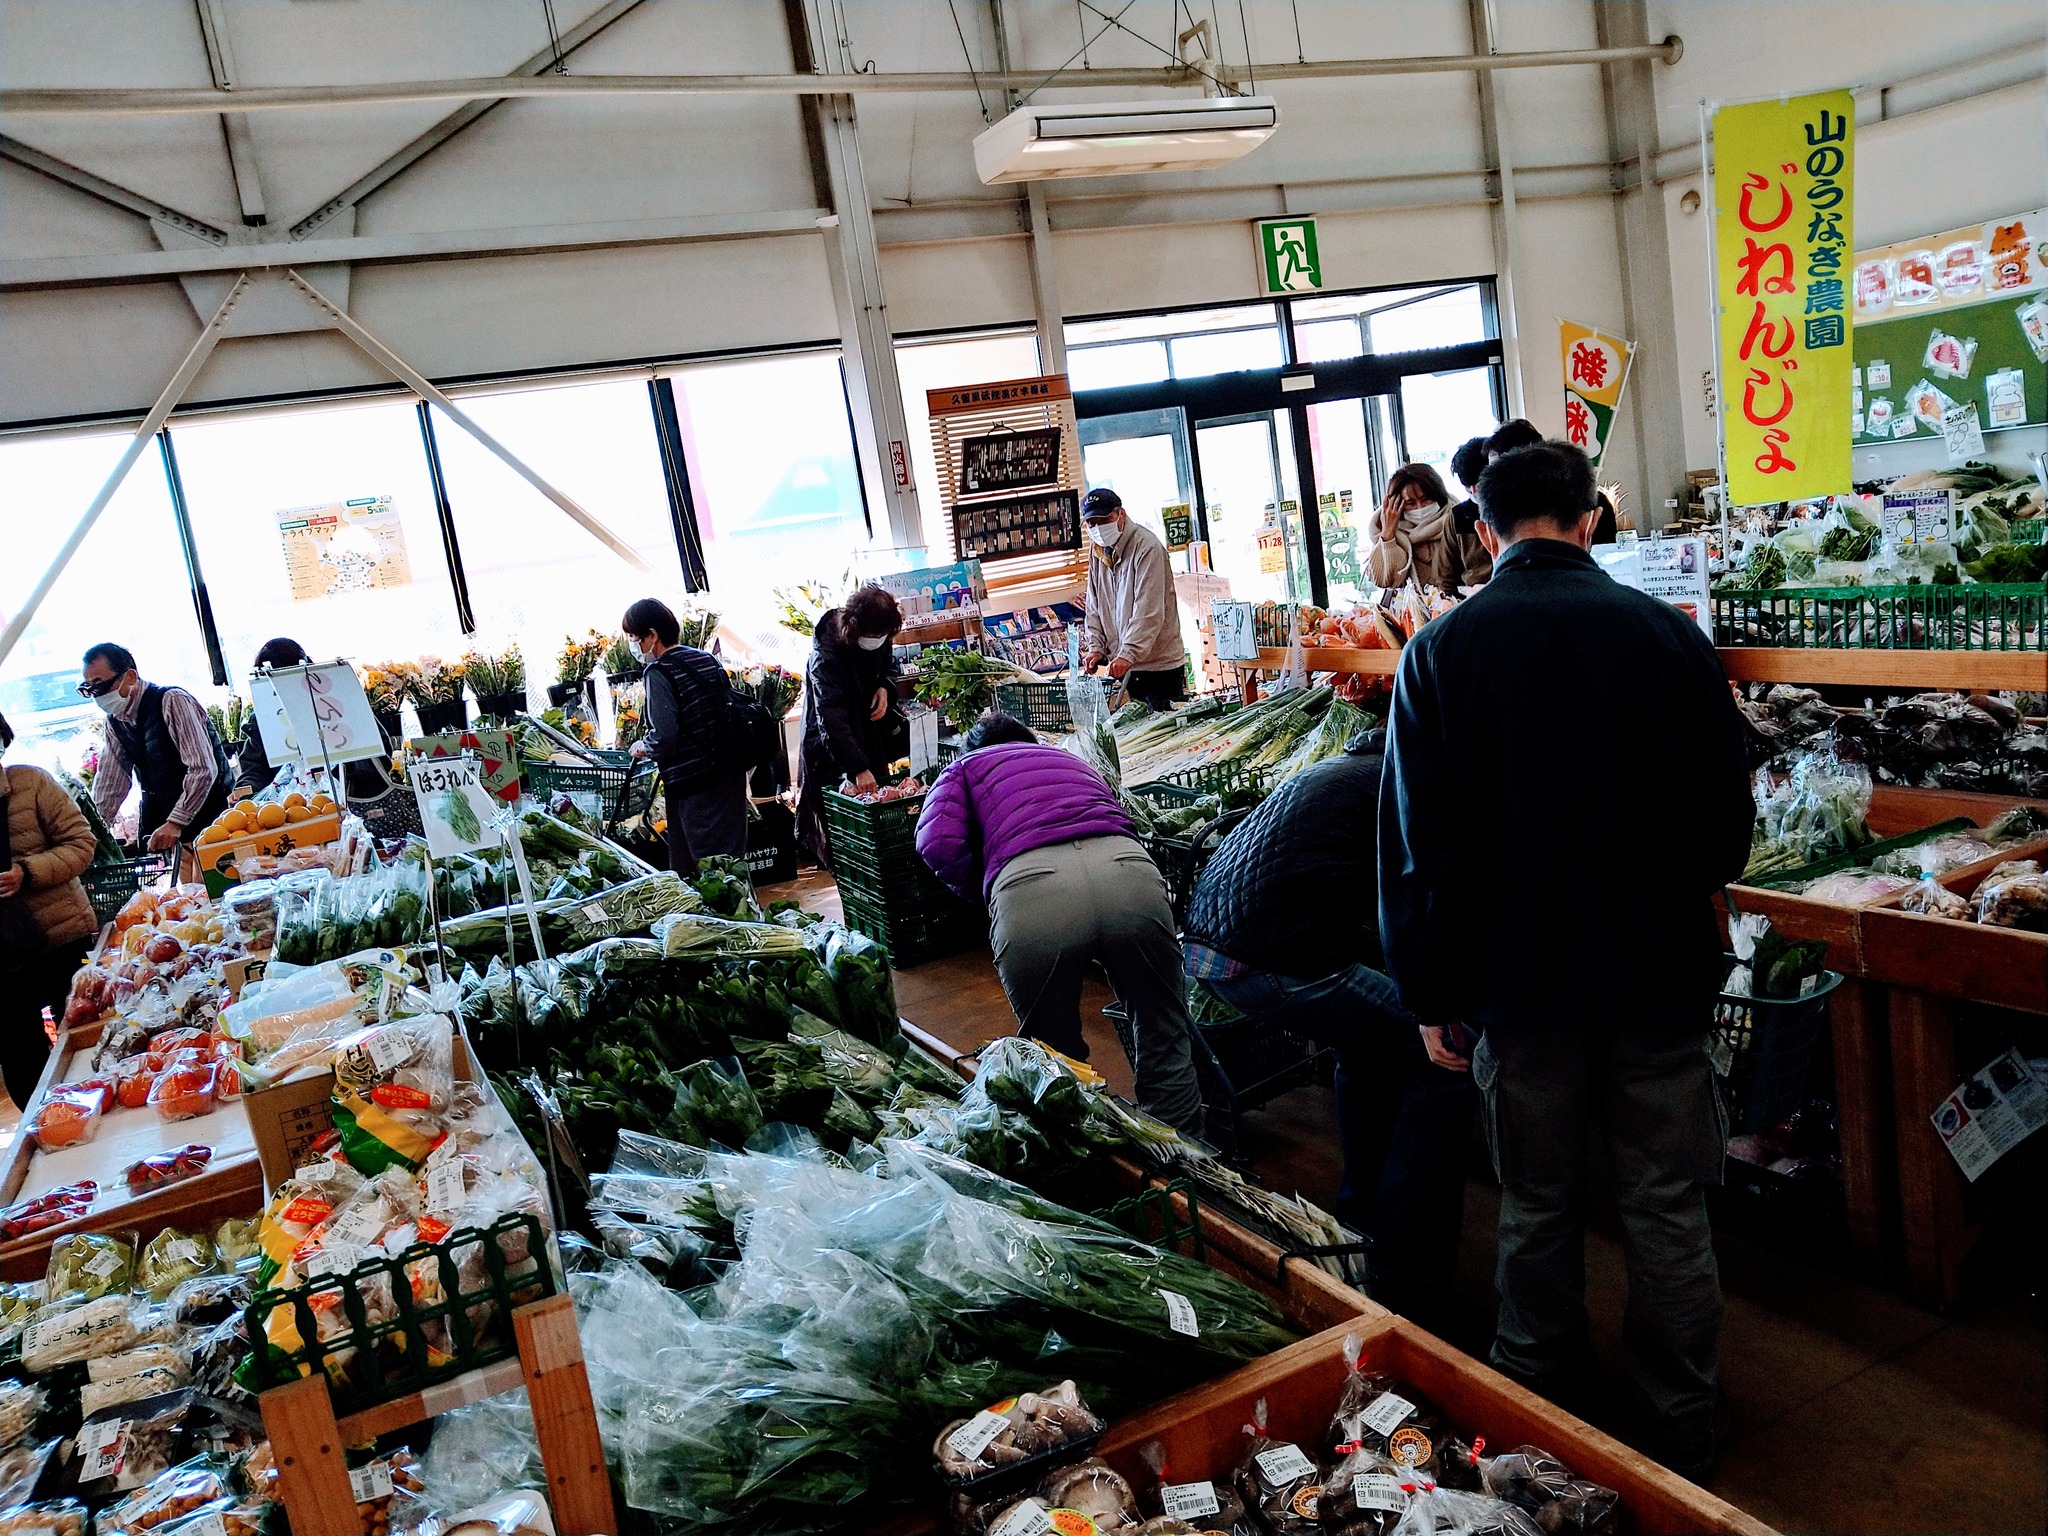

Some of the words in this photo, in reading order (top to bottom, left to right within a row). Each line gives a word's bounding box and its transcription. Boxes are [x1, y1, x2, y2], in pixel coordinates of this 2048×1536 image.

[1805, 109, 1846, 350] 山のうなぎ農園
[1736, 162, 1799, 475] じねんじょ
[281, 523, 338, 539] ドライブマップ
[1199, 1506, 1216, 1514] ¥240
[1034, 1520, 1050, 1534] ¥200
